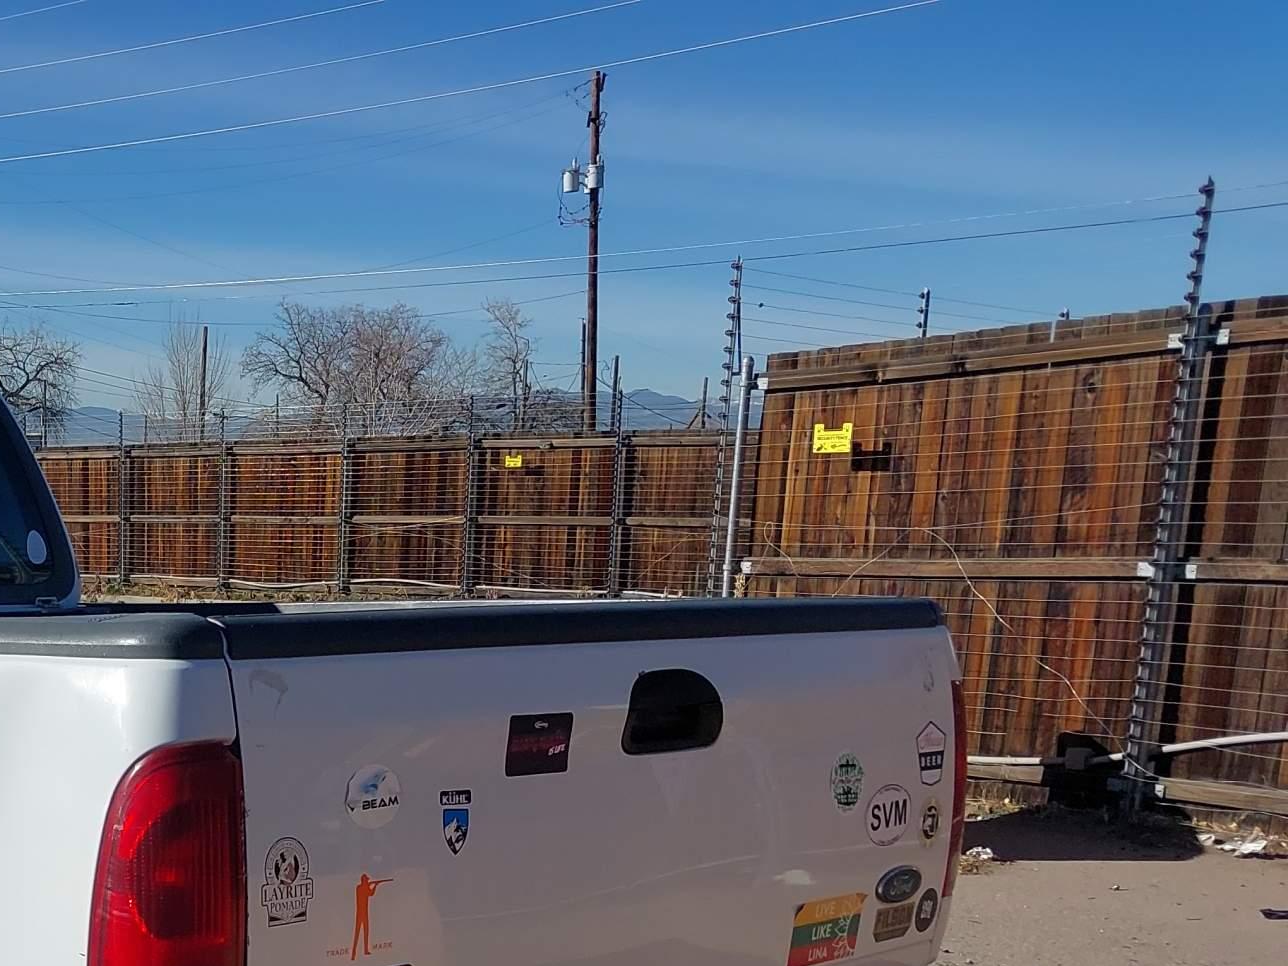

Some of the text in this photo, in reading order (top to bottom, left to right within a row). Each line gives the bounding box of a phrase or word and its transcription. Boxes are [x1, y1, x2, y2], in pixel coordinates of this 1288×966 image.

[362, 795, 400, 811] BEAM
[441, 790, 470, 805] KÜHL
[870, 798, 908, 832] SVM
[263, 882, 312, 903] LAYRITE
[269, 897, 307, 914] POMADE
[815, 902, 835, 917] LIVE
[812, 923, 832, 941] LIKE
